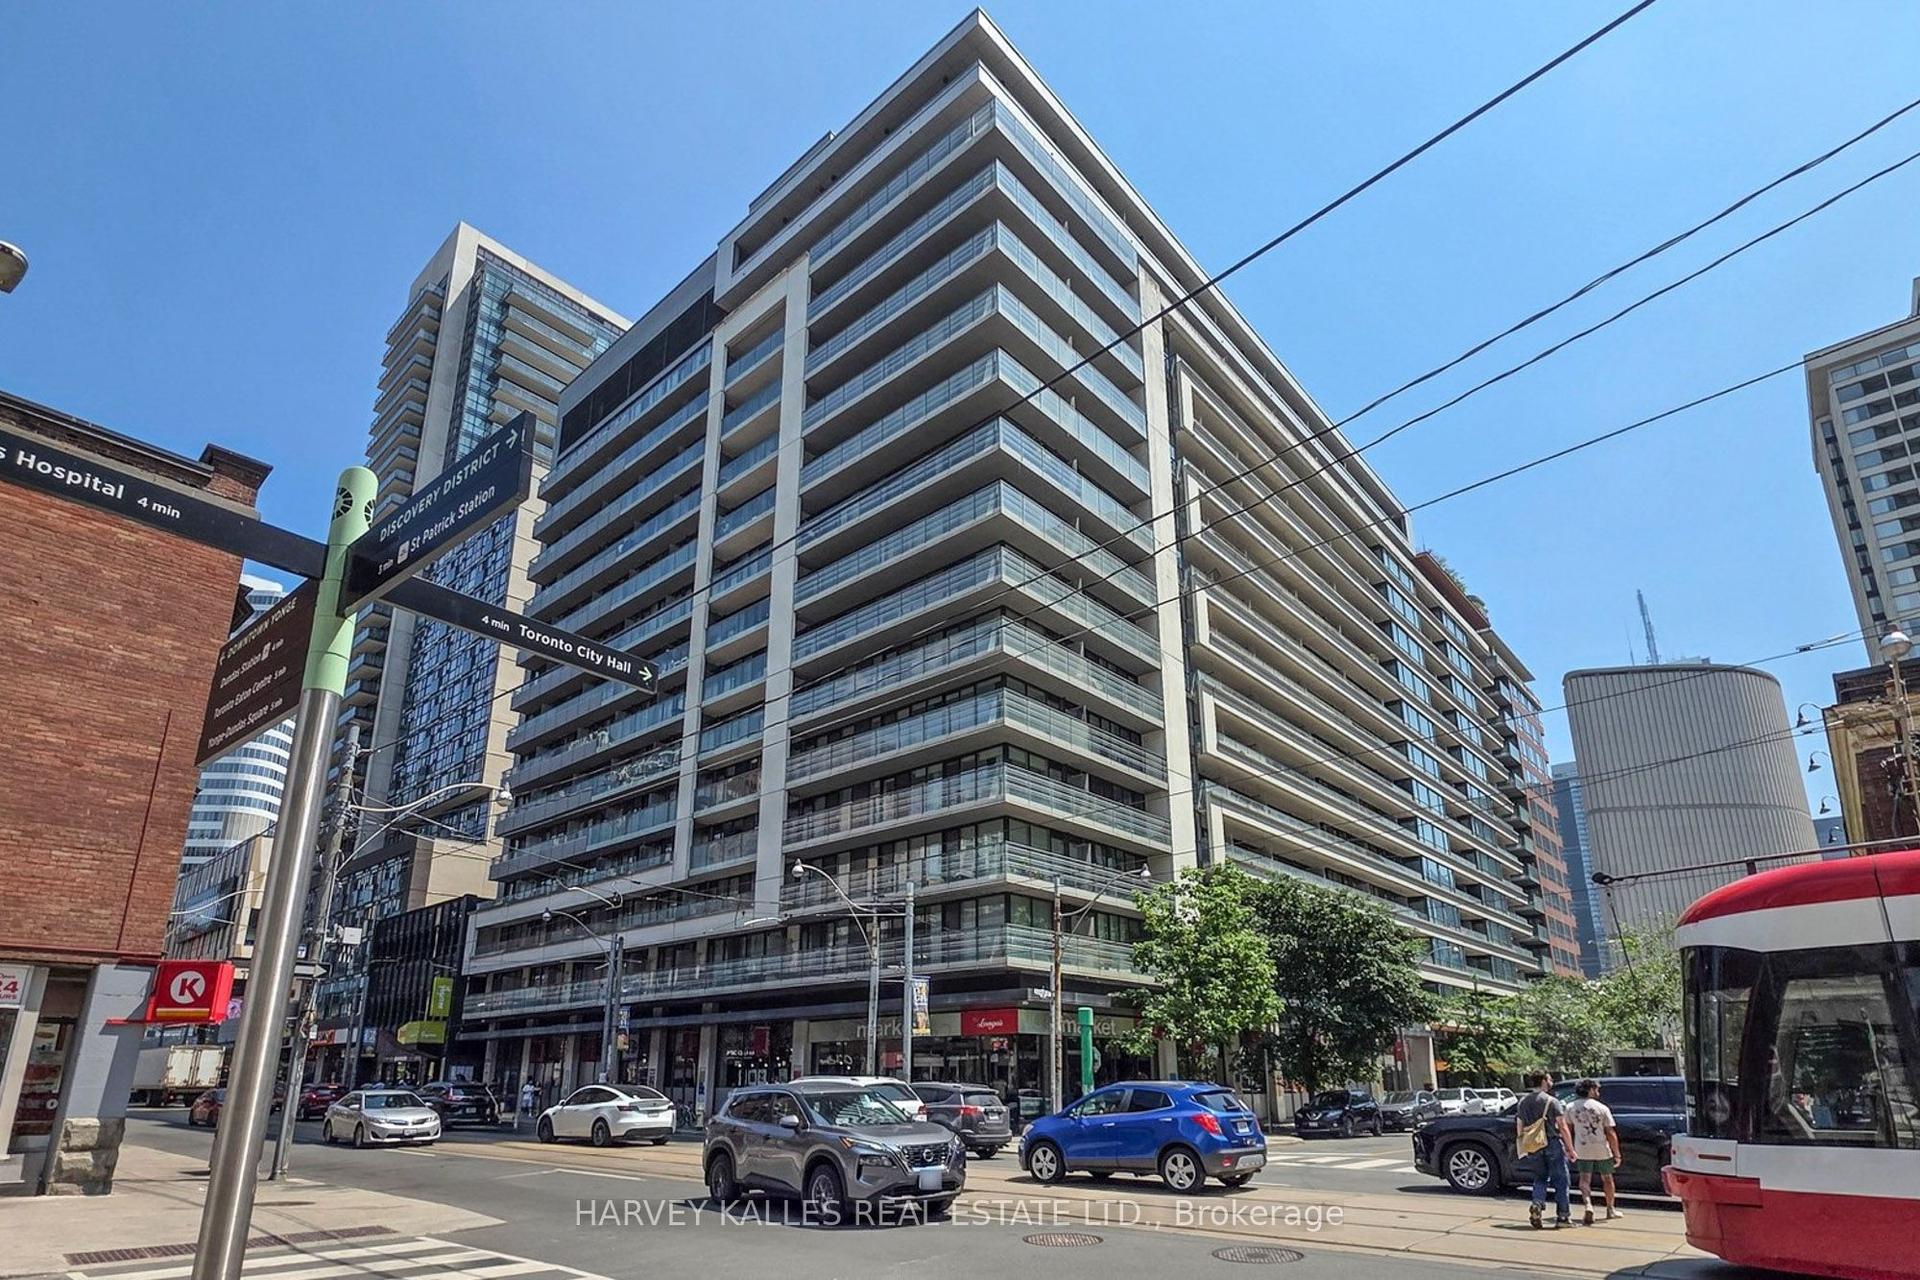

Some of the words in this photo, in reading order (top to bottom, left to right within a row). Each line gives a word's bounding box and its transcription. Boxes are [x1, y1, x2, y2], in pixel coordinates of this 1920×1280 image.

[16, 451, 125, 500] Hospital
[137, 497, 149, 508] 4
[152, 503, 181, 519] min
[379, 487, 441, 542] DISCOVERY
[443, 442, 500, 495] DISTRICT
[410, 537, 421, 552] St
[422, 512, 456, 545] Patrick
[458, 486, 496, 520] Station
[227, 619, 270, 659] DOWNTOWN
[271, 596, 298, 625] YONGE
[481, 615, 489, 624] 4
[491, 620, 510, 632] min
[519, 624, 573, 653] Toronto
[577, 645, 603, 665] City
[607, 655, 631, 674] Hall
[1062, 1018, 1116, 1036] mket
